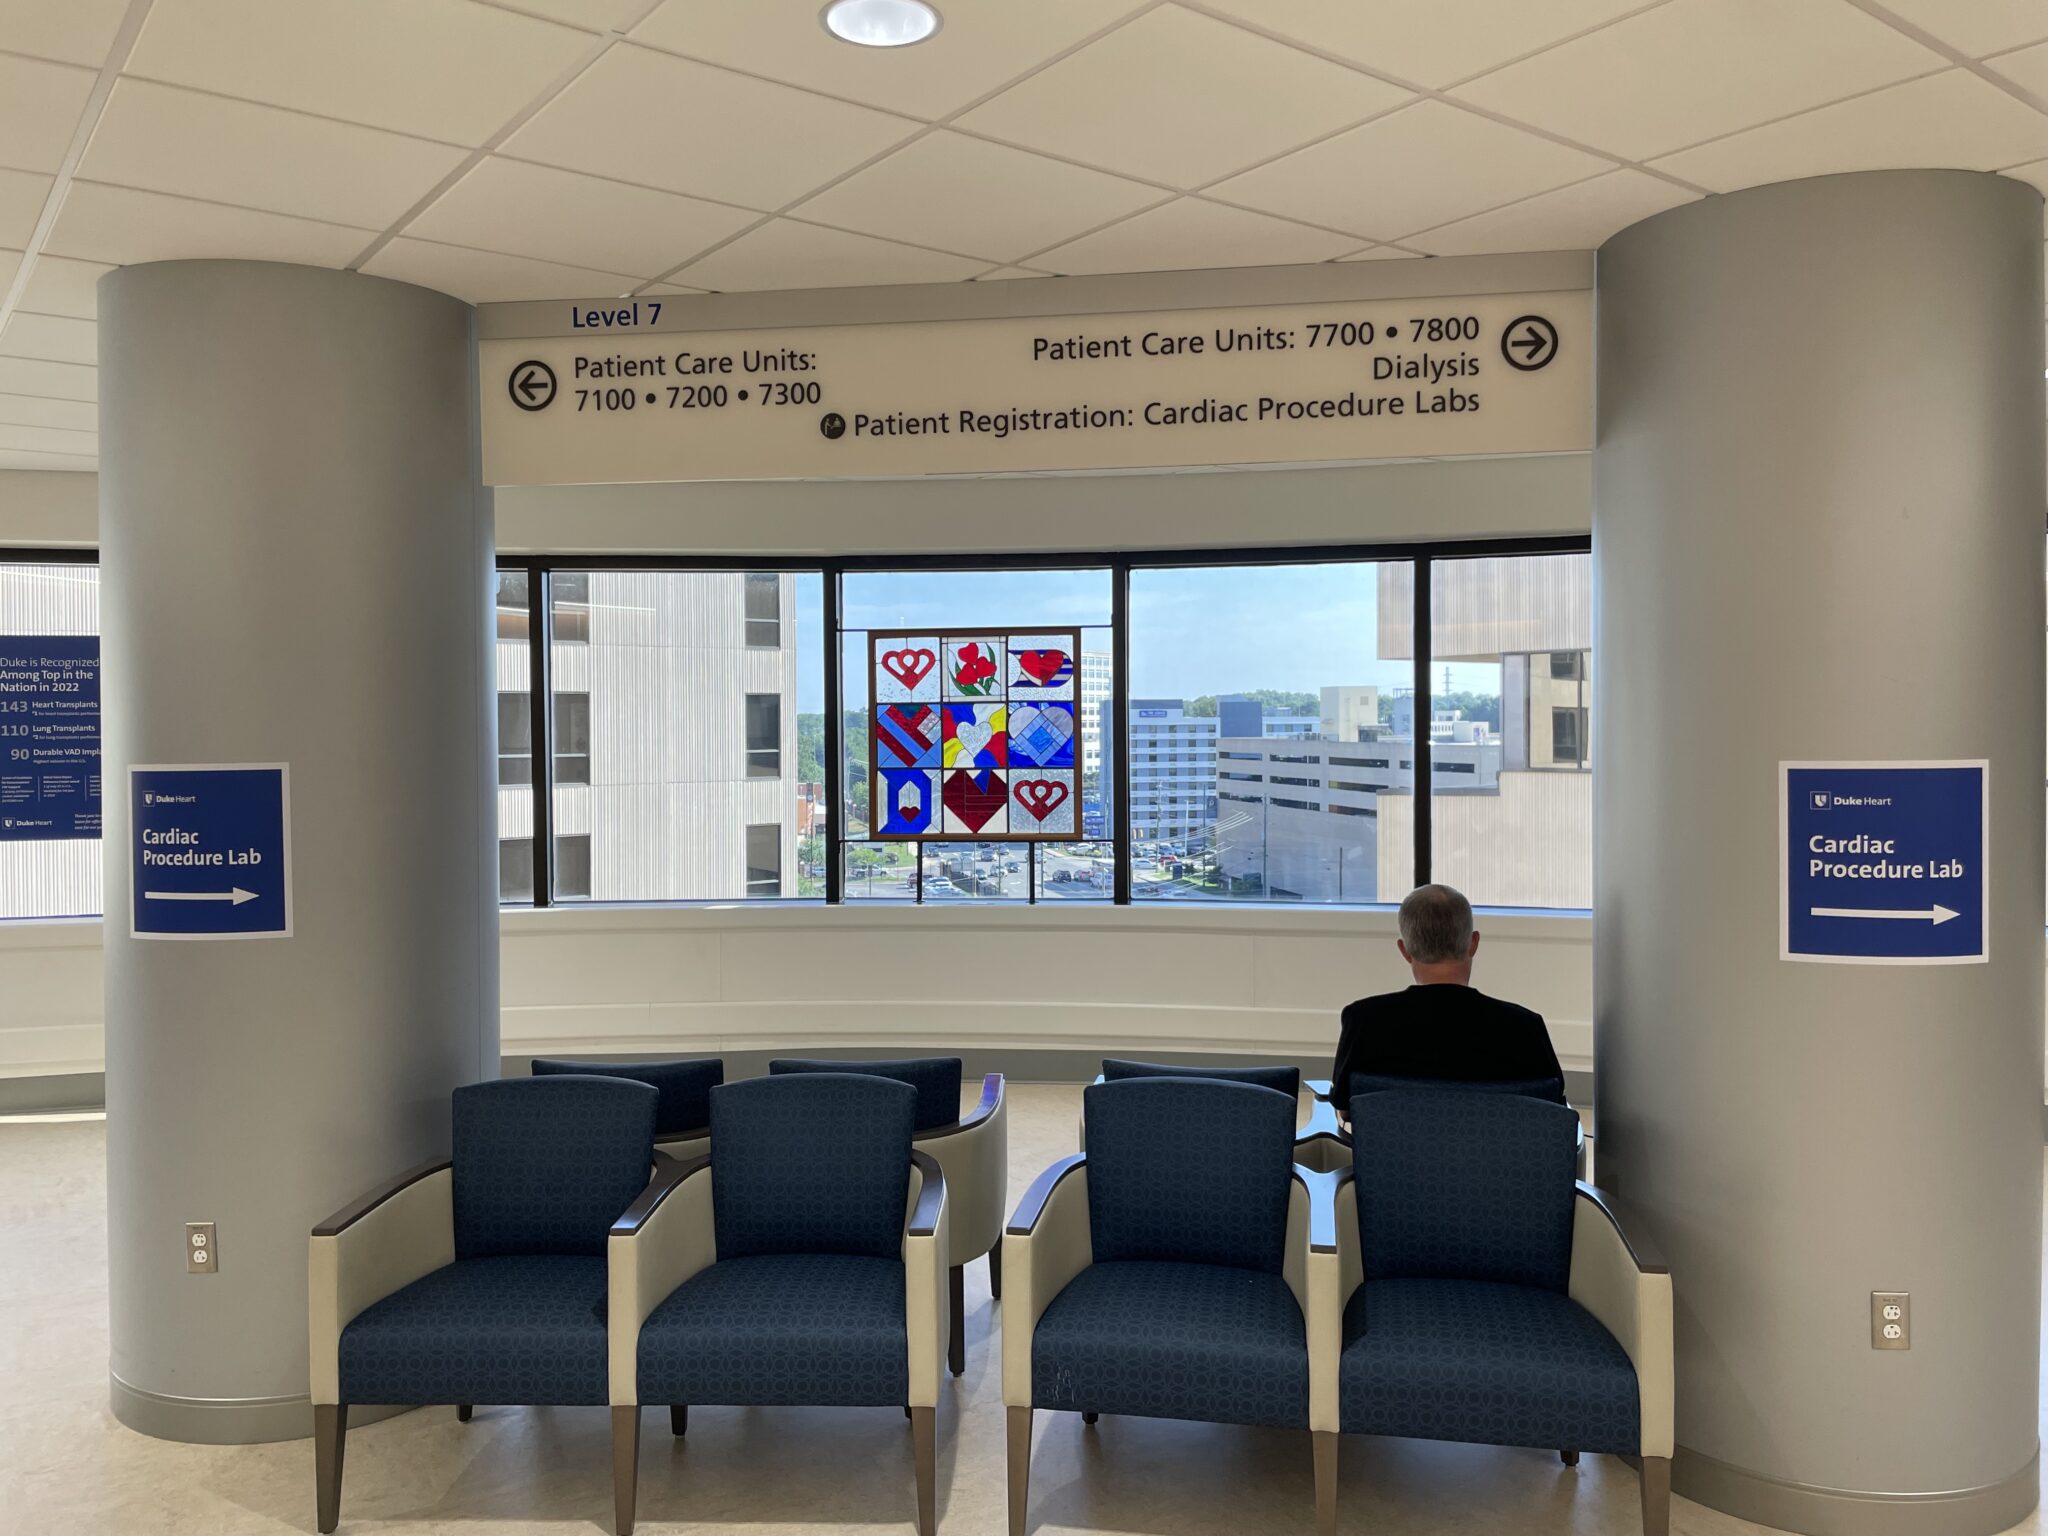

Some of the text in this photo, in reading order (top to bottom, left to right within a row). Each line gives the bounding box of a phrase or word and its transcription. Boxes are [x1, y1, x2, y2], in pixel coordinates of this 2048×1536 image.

[572, 303, 662, 329] Level 7
[1033, 316, 1480, 361] Patient Care Units: 7700 7800
[575, 348, 817, 379] Patient Care Units:
[1373, 353, 1480, 384] Dialysis
[575, 381, 822, 412] 7100 7200 7300
[853, 388, 1480, 437] Patient Registration: Cardiac Procedure Labs
[0, 657, 100, 670] Duke is Recognized
[0, 670, 94, 682] Among Top in the
[0, 682, 80, 692] Nation in 2022
[0, 701, 98, 713] 143 Heart Transplants
[1, 724, 96, 737] 110 Lung Transplants
[11, 748, 30, 761] 90
[33, 748, 63, 756] Durable
[64, 748, 81, 756] VAD
[156, 794, 196, 803] Duke Heart
[1834, 796, 1892, 806] Duke Heart
[143, 828, 199, 845] Cardiac
[1809, 834, 1895, 854] Cardiac
[143, 848, 262, 866] Procedure Lab
[1810, 858, 1963, 879] Procedure Lab
